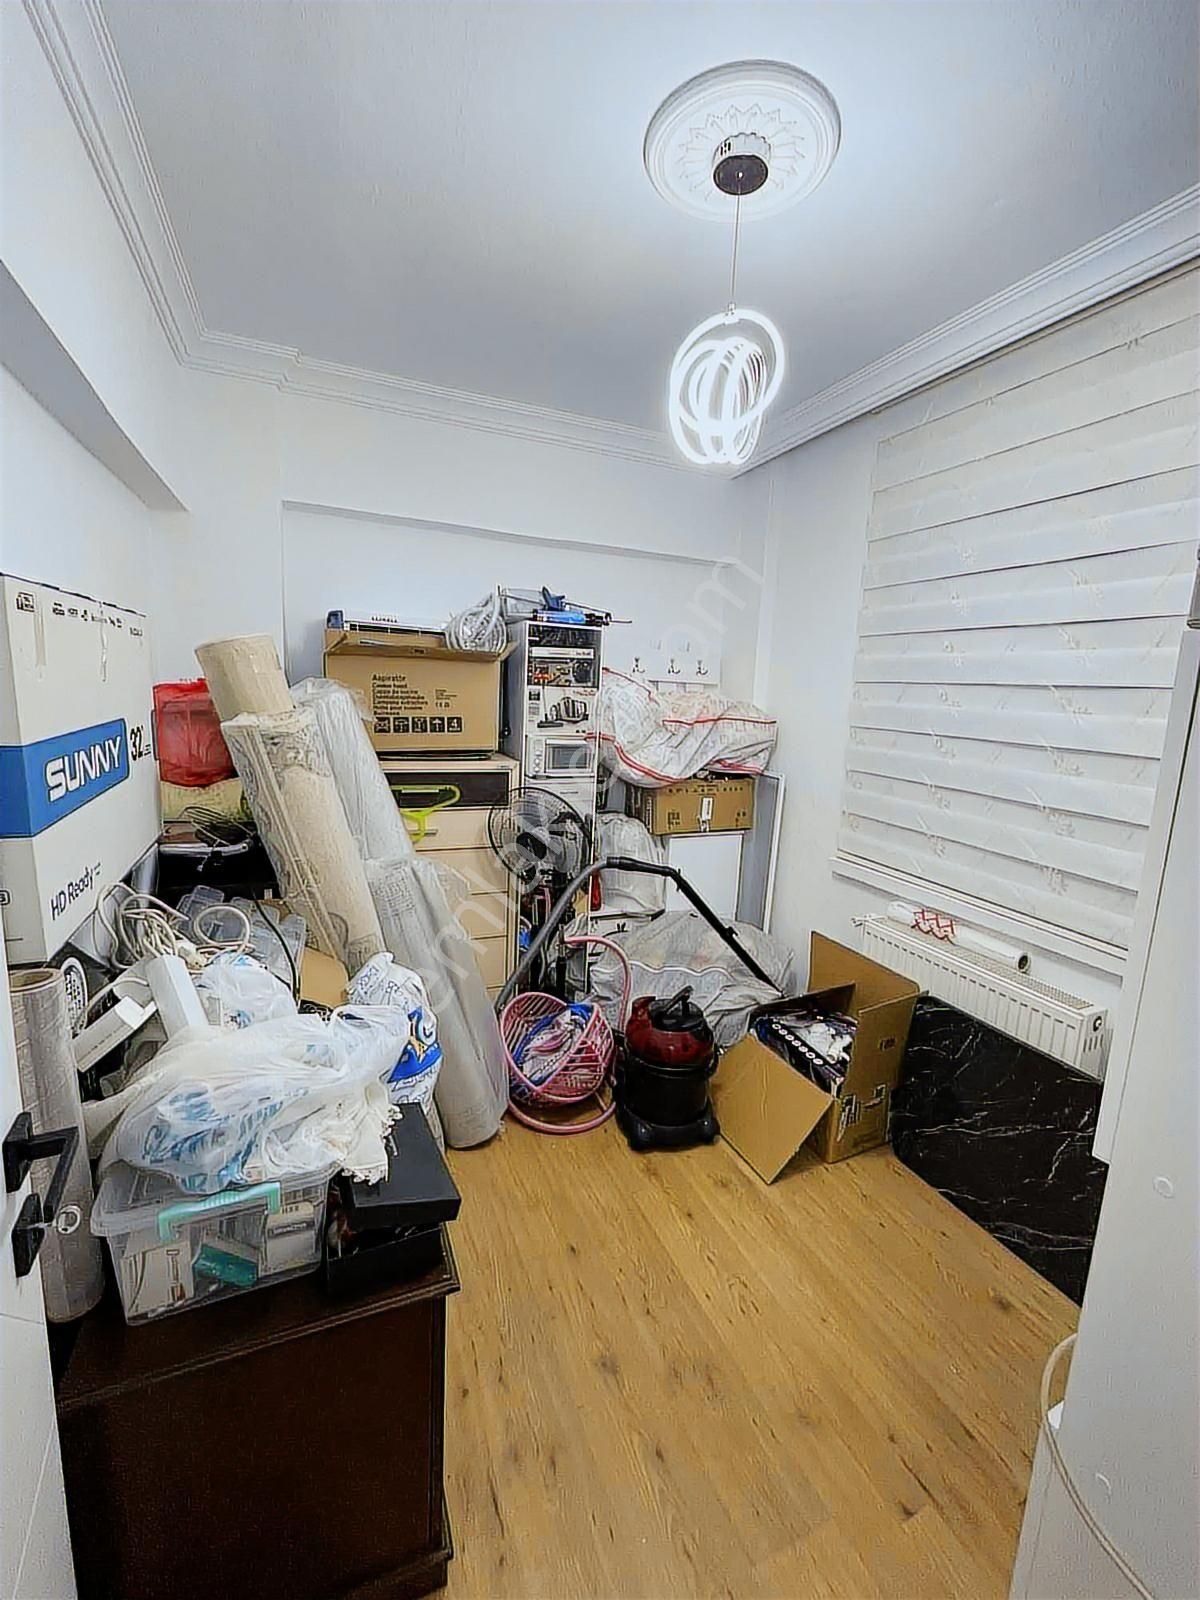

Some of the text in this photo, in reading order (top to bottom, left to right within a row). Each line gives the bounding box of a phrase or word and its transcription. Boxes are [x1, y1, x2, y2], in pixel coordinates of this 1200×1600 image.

[46, 736, 121, 802] SUNNY
[50, 890, 67, 921] HD
[68, 866, 94, 906] Ready
